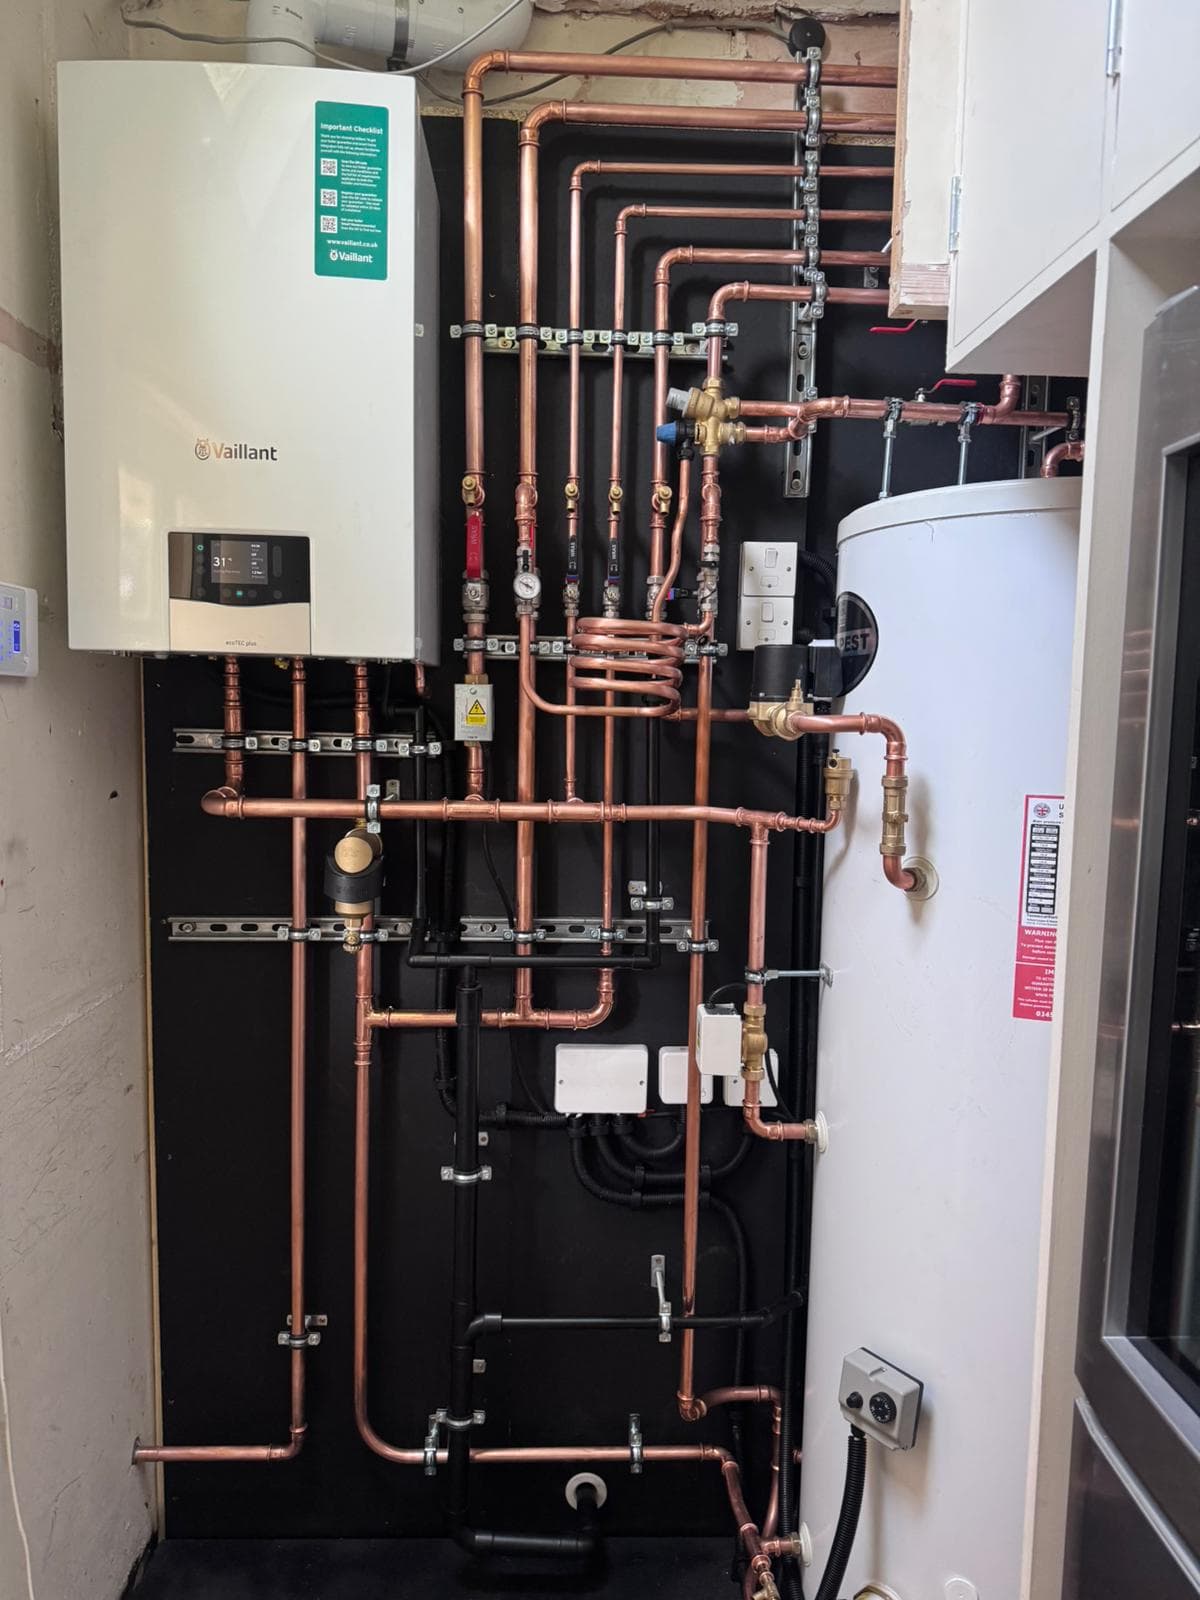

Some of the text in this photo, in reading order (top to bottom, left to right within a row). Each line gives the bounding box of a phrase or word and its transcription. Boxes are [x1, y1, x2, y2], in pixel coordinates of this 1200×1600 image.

[320, 122, 383, 135] Important Checklist
[338, 251, 373, 263] Vaillant
[211, 442, 278, 461] Vaillant
[225, 639, 257, 648] ecoTEC plus
[1024, 928, 1057, 937] WARNIN
